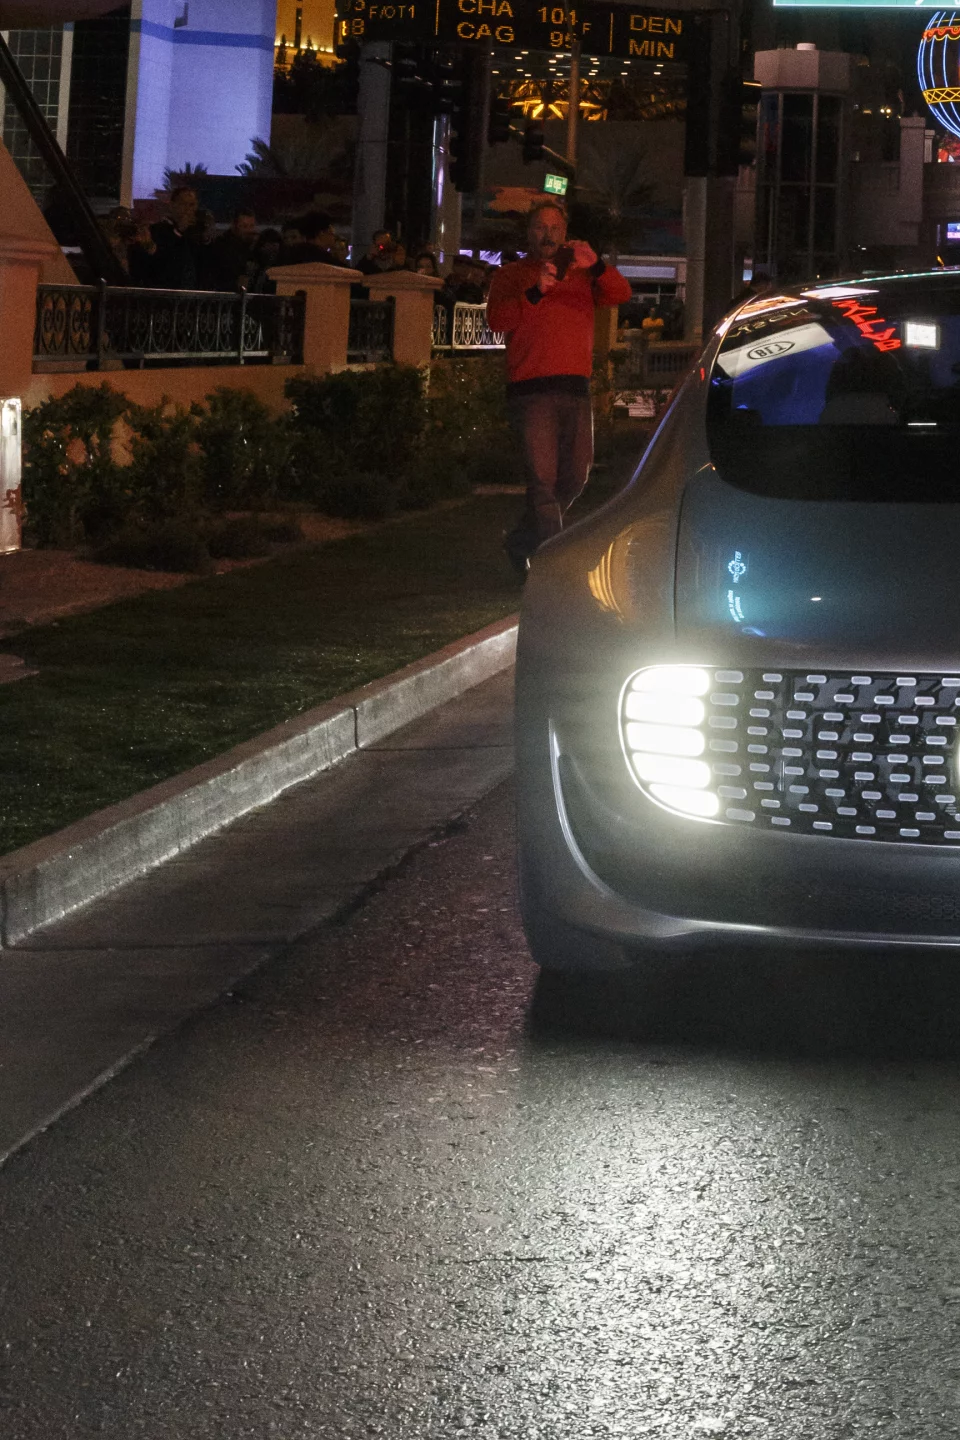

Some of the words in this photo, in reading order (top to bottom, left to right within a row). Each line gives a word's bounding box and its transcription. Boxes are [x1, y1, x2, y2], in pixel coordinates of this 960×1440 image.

[457, 21, 515, 43] CAG
[630, 14, 683, 36] DEN
[629, 39, 675, 59] MIN
